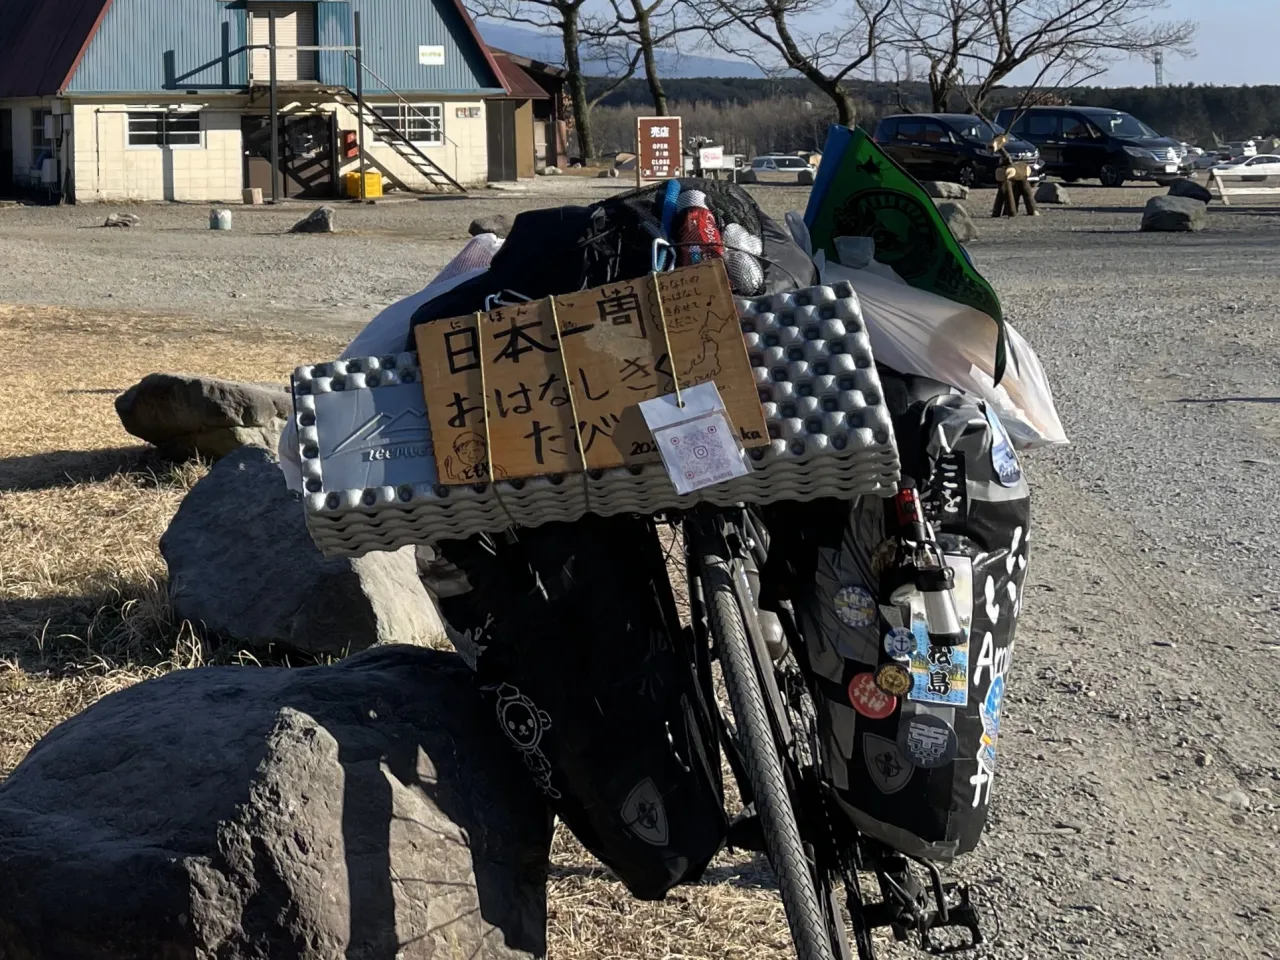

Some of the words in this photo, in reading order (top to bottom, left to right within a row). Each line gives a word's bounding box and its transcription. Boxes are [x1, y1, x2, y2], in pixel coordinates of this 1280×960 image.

[650, 126, 670, 138] 売店
[444, 293, 648, 375] 日本一周
[523, 412, 620, 465] たび
